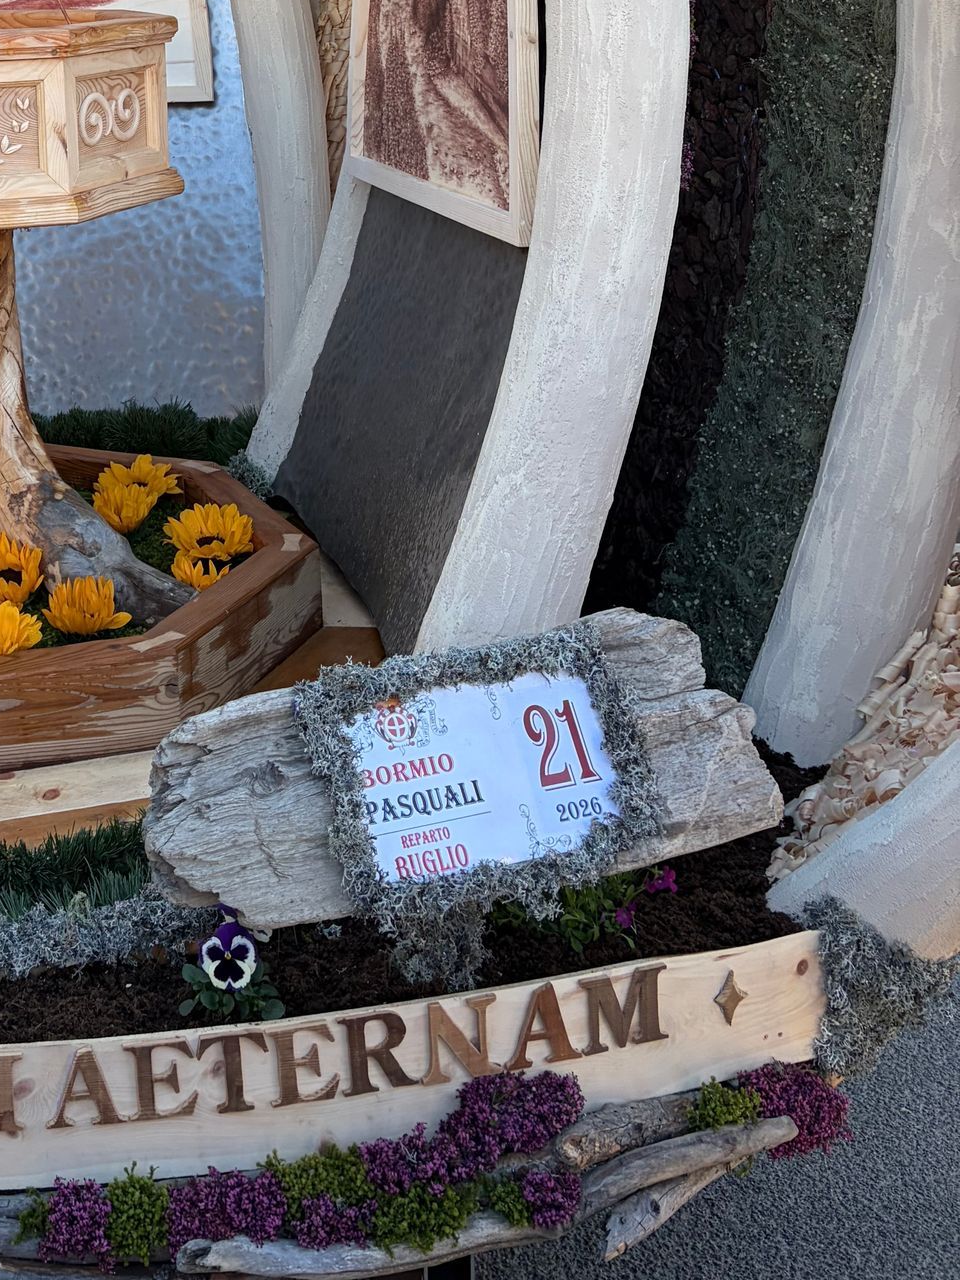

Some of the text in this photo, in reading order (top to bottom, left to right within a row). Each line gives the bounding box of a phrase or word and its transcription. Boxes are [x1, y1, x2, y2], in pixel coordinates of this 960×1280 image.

[523, 699, 603, 791] 21
[359, 753, 454, 789] BORMIO
[365, 779, 486, 825] PASQUALI
[556, 797, 603, 822] 2026
[400, 826, 451, 849] REPARTO
[45, 962, 670, 1130] AETERNAM
